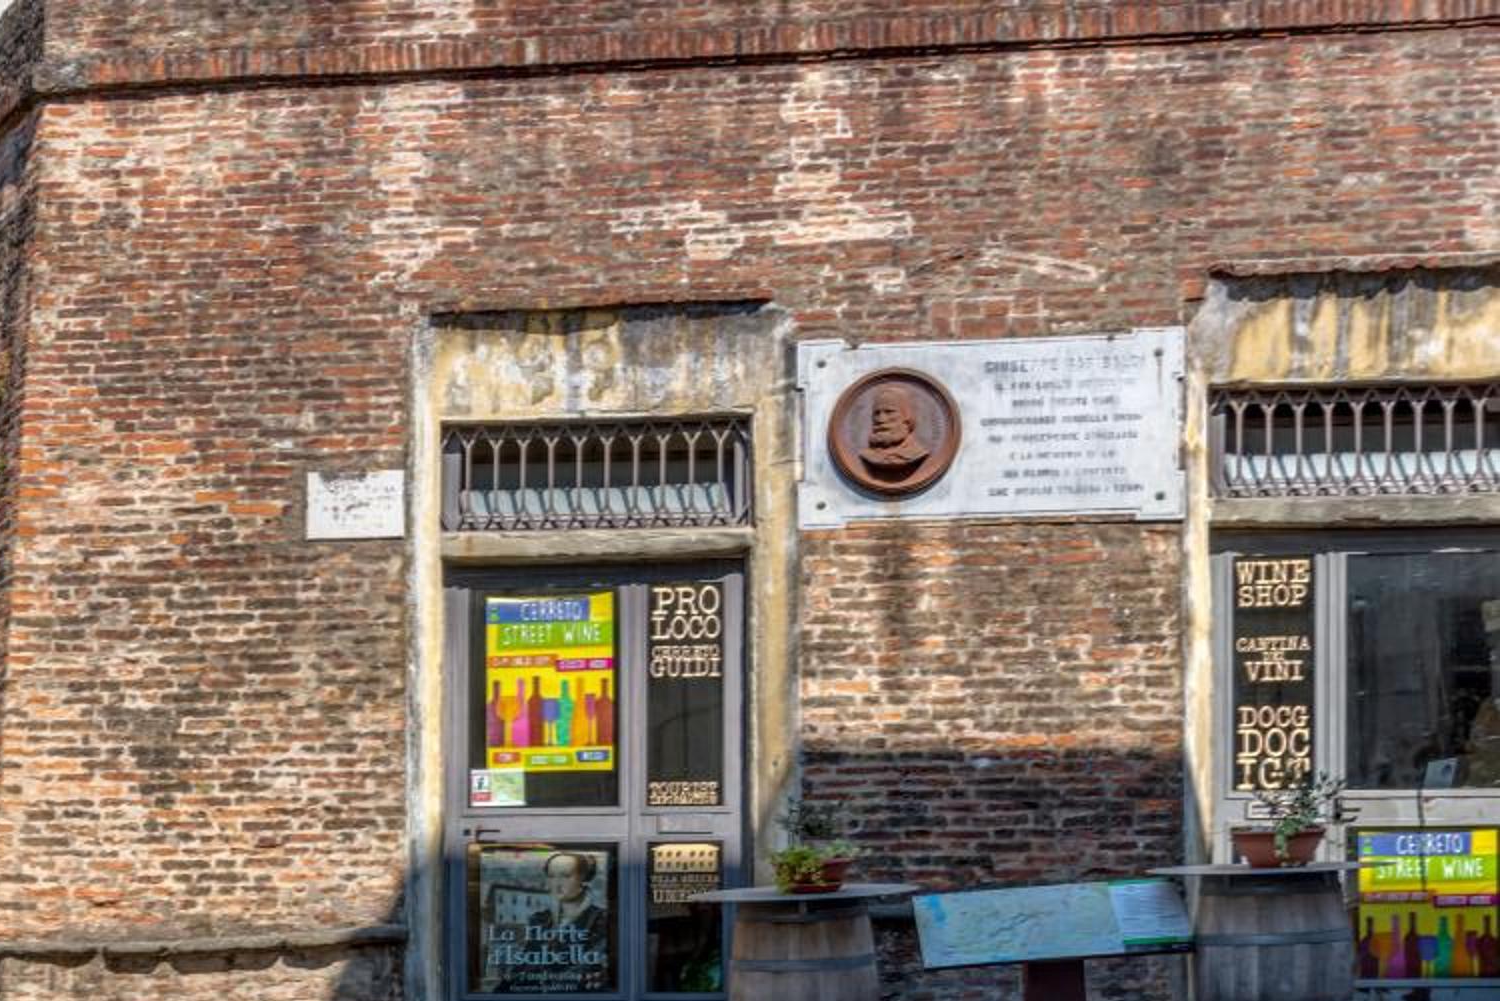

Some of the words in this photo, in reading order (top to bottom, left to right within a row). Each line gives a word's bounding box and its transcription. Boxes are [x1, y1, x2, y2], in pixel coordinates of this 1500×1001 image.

[1236, 559, 1311, 585] WINE
[651, 585, 720, 615] PRO
[1237, 584, 1308, 608] SHOP
[519, 600, 583, 621] CERRETO
[501, 623, 553, 646] STREET
[563, 623, 602, 643] WINE
[650, 614, 721, 640] LOCO
[1235, 635, 1311, 653] CANTINA
[650, 656, 722, 678] GUIDI
[1243, 660, 1305, 682] VINI
[1236, 705, 1310, 728] DOCG
[1236, 727, 1311, 757] DOC
[1236, 757, 1311, 790] IGT
[1442, 857, 1485, 879] WINE
[488, 924, 516, 942] La
[524, 921, 589, 943] Notte
